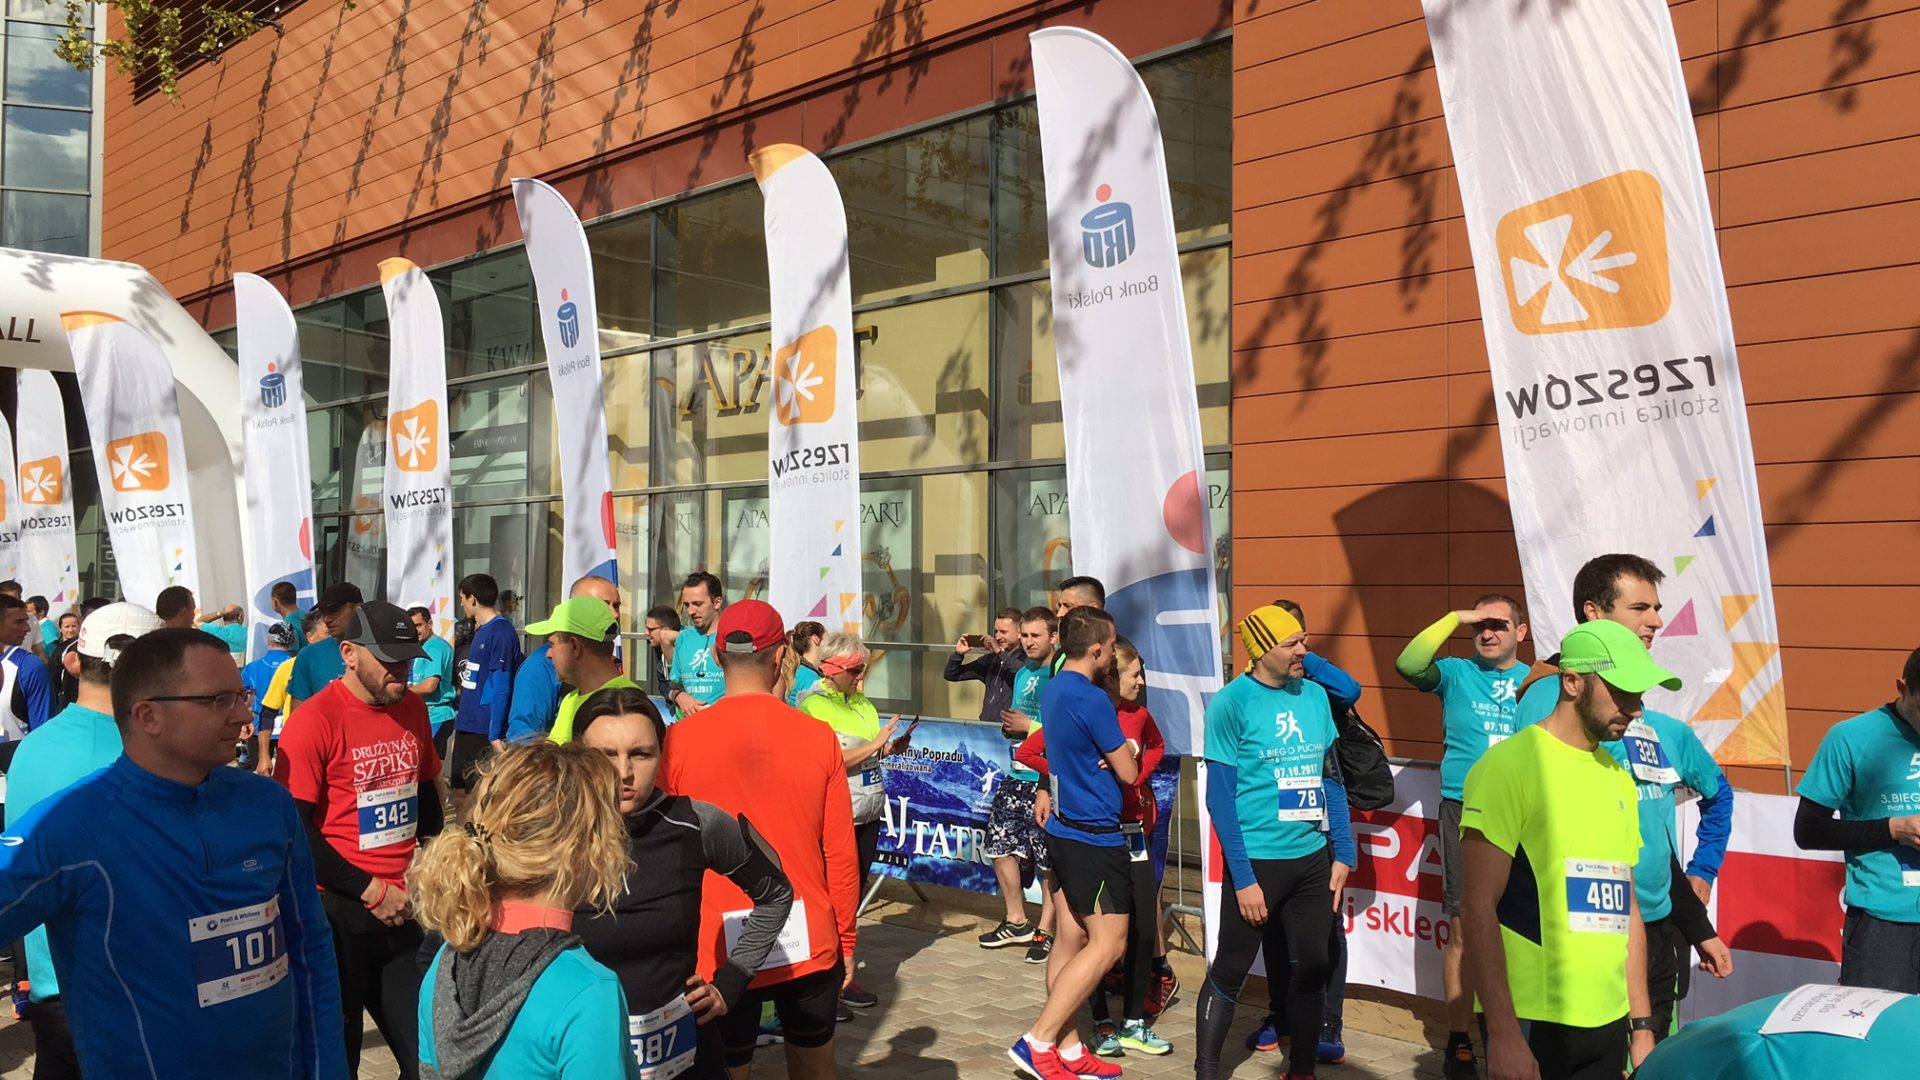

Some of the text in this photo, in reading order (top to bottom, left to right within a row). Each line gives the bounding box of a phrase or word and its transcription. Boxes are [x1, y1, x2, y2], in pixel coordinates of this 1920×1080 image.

[1275, 712, 1288, 738] 5
[352, 739, 408, 761] DRUŻYNA
[922, 747, 964, 763] Popradu
[1267, 748, 1286, 757] BIEG
[1635, 739, 1659, 765] 328
[353, 750, 419, 784] SZPIKU
[868, 770, 882, 784] 22
[1274, 764, 1318, 779] 07.10.2017
[1297, 789, 1317, 807] 78
[374, 801, 409, 830] 342
[1587, 882, 1623, 911] 480
[1366, 901, 1449, 950] sklep
[226, 926, 276, 970] 101
[630, 1025, 678, 1066] 387
